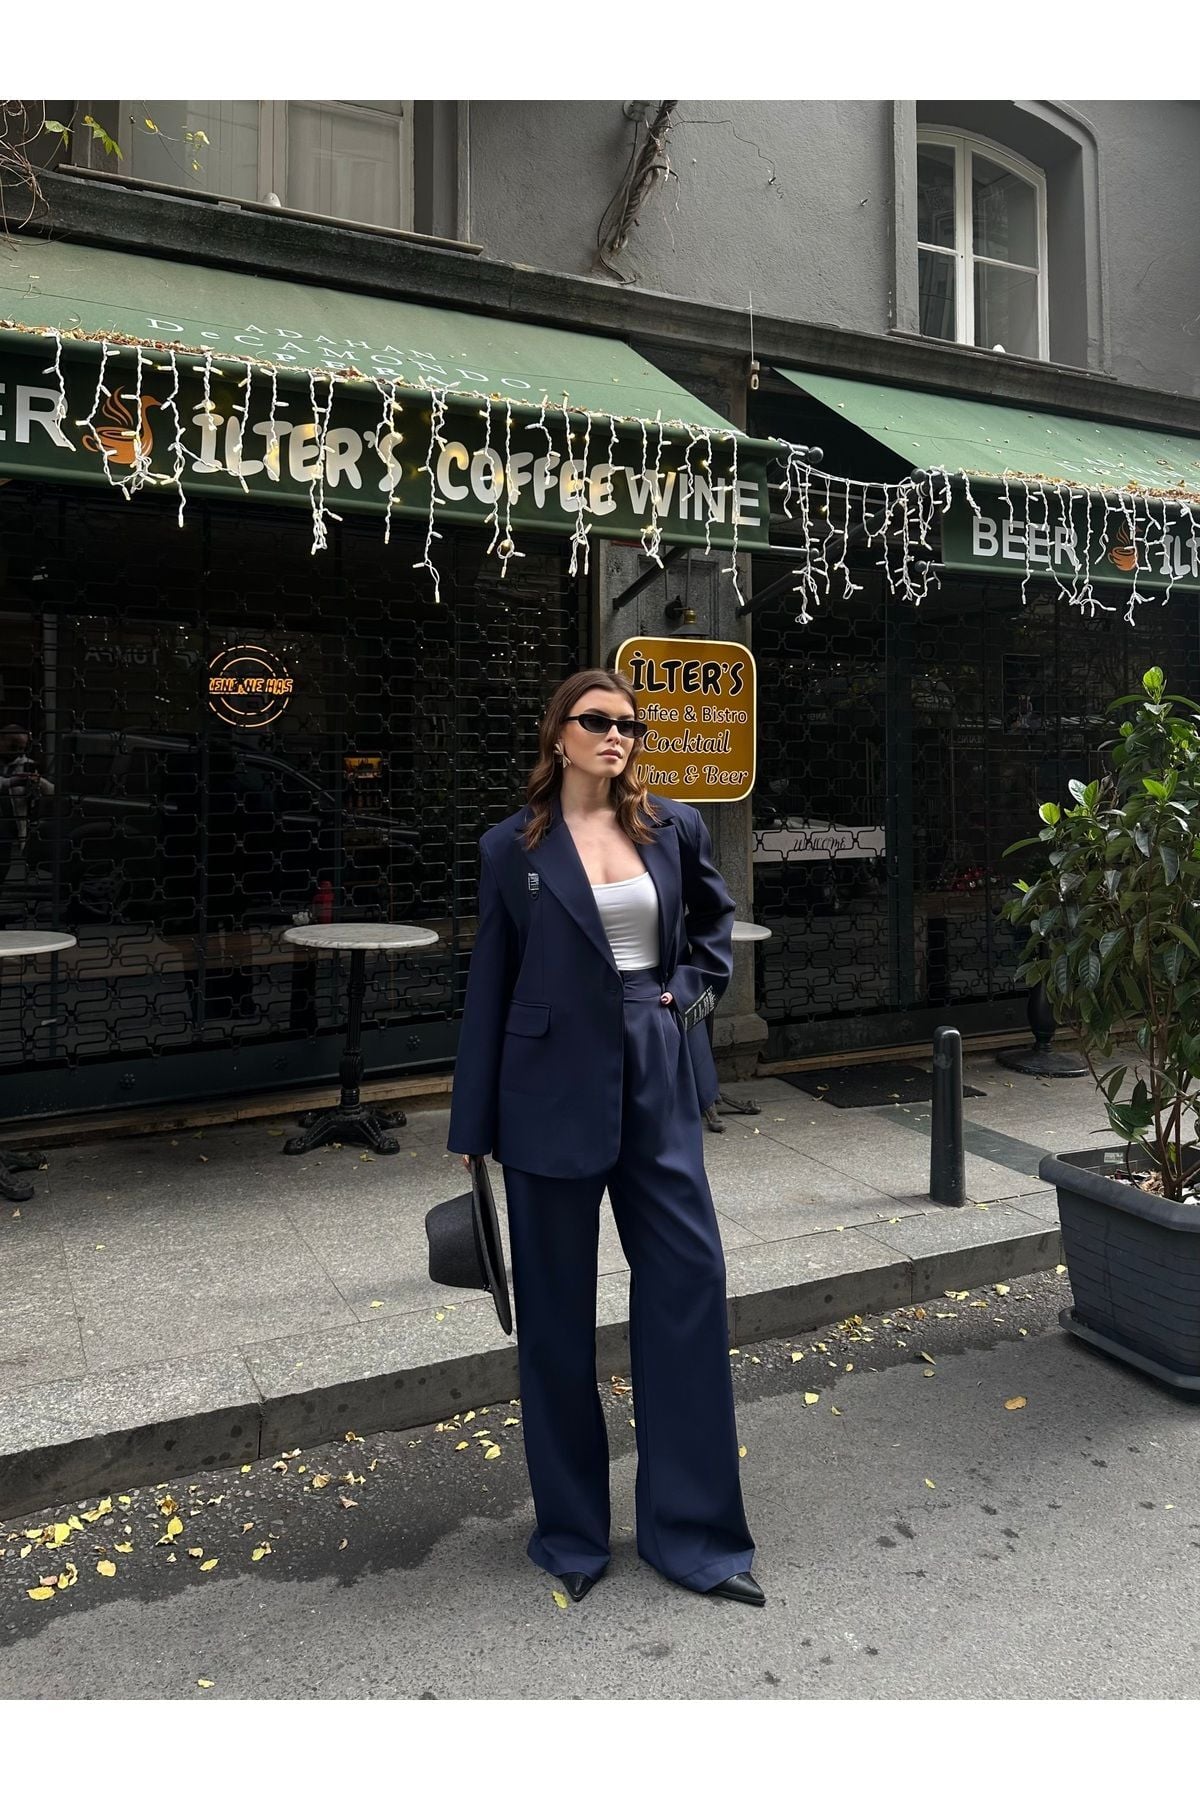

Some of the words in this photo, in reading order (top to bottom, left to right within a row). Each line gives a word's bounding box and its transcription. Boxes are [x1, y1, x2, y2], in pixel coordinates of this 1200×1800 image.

[245, 324, 437, 361] ADAHAN
[436, 441, 617, 516] COFFEE
[625, 466, 761, 527] WINE
[972, 515, 1080, 567] BEER
[629, 651, 744, 697] İLTER'S
[638, 703, 679, 722] offee
[683, 705, 698, 722] &
[702, 706, 748, 724] Bistro
[643, 728, 732, 754] Cocktail
[683, 765, 700, 785] &
[703, 765, 749, 785] Beer
